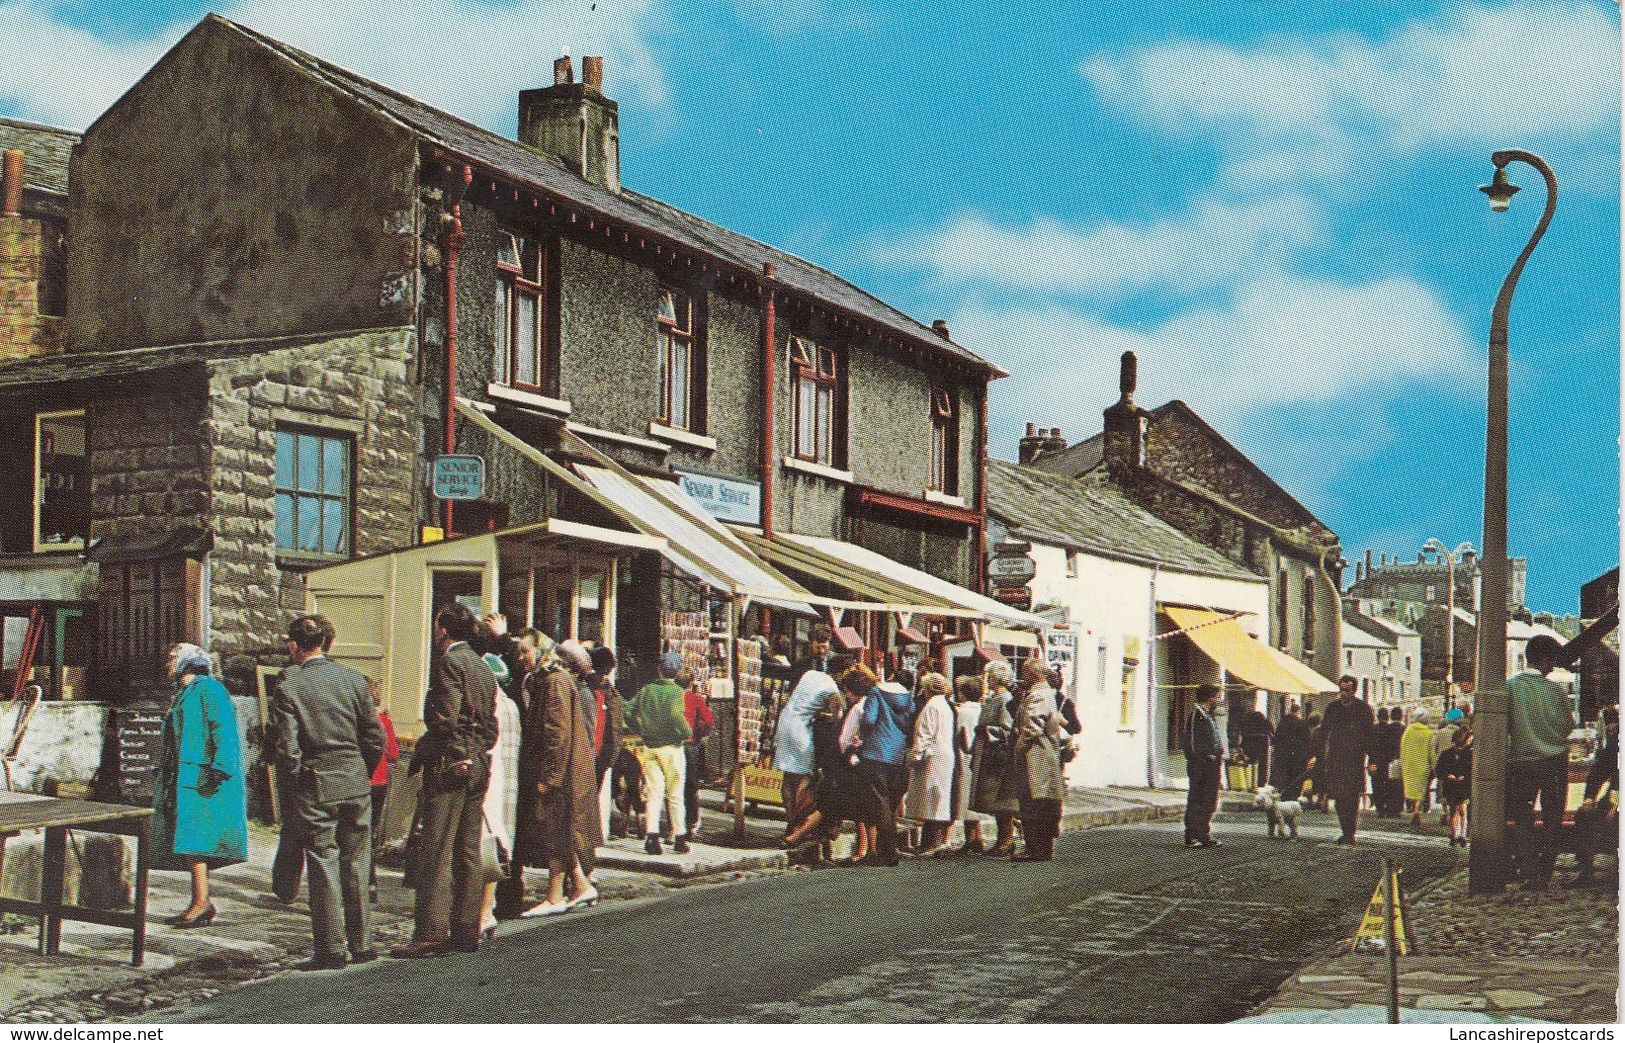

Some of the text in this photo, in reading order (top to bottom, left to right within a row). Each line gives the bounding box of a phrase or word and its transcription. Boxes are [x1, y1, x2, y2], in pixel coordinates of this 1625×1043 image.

[440, 462, 479, 473] SENIOR
[437, 474, 479, 485] SERVICE
[1047, 634, 1073, 647] NETTLE
[1048, 649, 1072, 662] DRINK
